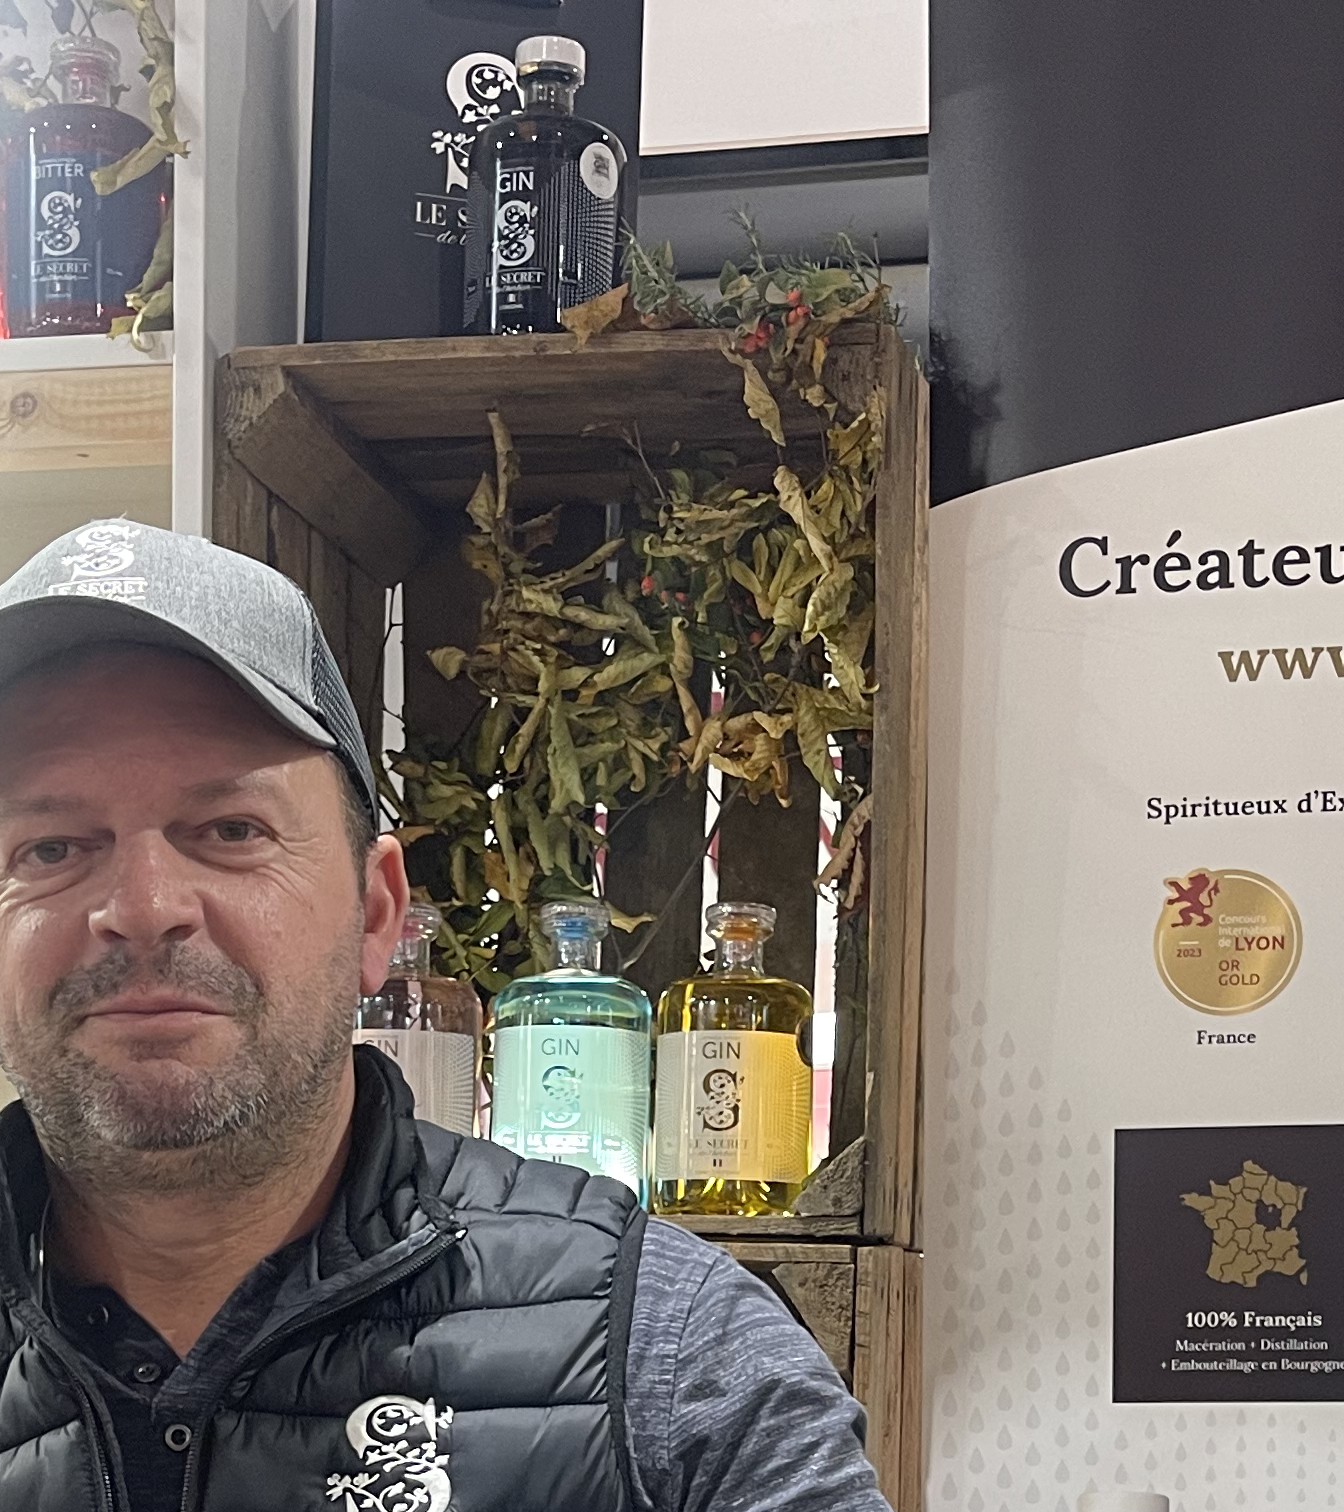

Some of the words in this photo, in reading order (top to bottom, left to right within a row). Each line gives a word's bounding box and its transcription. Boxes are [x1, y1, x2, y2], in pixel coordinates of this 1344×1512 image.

[34, 163, 84, 179] BITTER
[498, 171, 535, 193] GIN
[416, 202, 446, 226] LE
[1146, 793, 1288, 824] Spiritueux
[1234, 936, 1286, 951] LYON
[1176, 948, 1202, 958] 2023
[1218, 960, 1240, 972] OR
[1218, 973, 1260, 986] GOLD
[1196, 1030, 1257, 1045] France
[541, 1038, 580, 1056] GIN
[702, 1041, 741, 1060] GIN
[1185, 1311, 1238, 1329] 100%
[1243, 1311, 1323, 1332] Français
[1175, 1338, 1246, 1352] Macération
[1260, 1337, 1329, 1351] Distillation
[1170, 1358, 1259, 1374] Embouteillage
[1261, 1360, 1278, 1371] en
